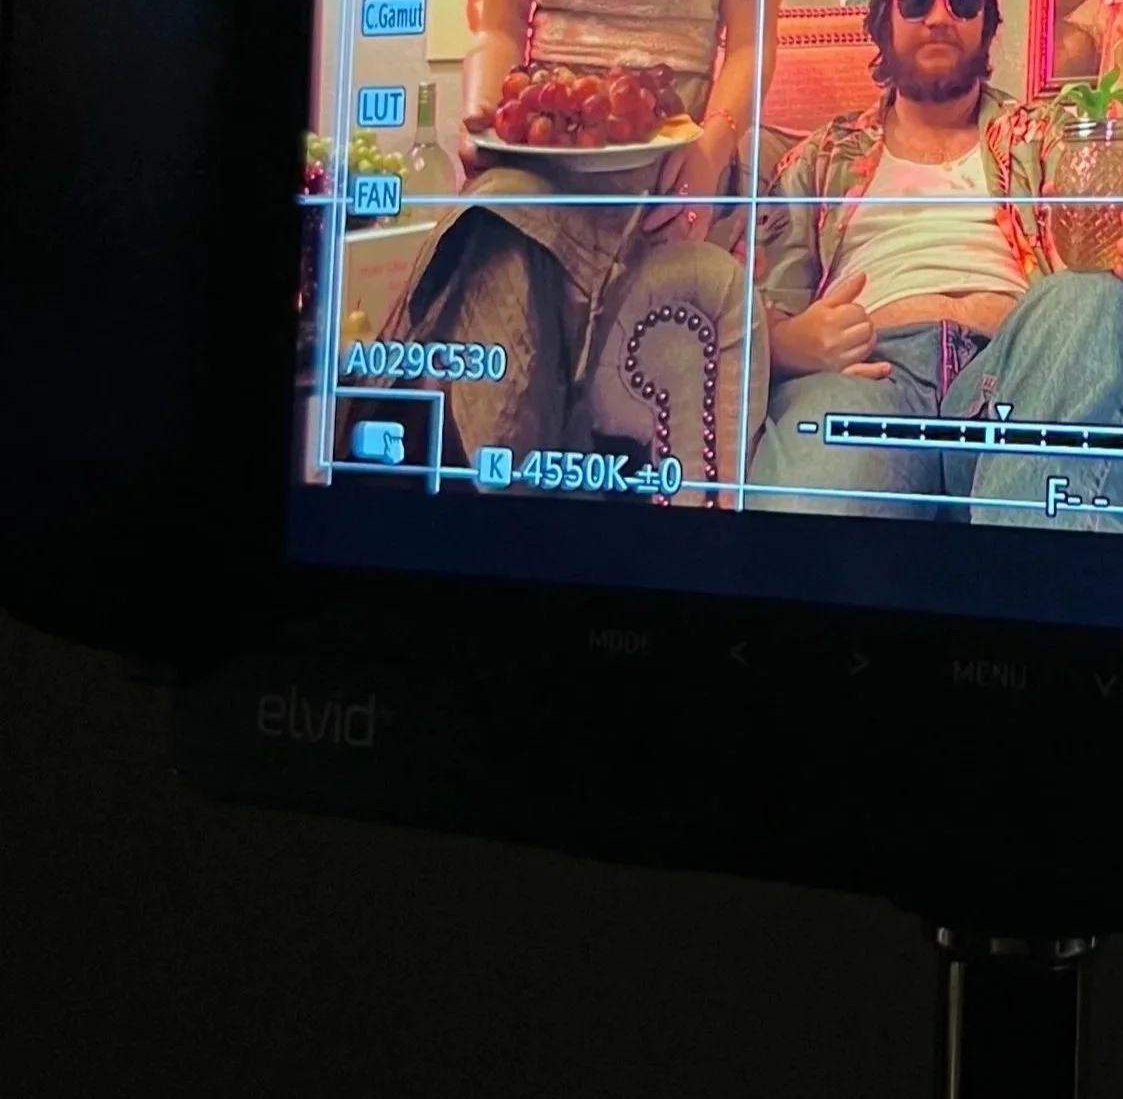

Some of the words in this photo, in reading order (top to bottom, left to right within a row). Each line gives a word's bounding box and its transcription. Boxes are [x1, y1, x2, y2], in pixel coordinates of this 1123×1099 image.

[364, 2, 425, 30] C.Gamut
[361, 93, 403, 123] LUT
[357, 181, 399, 210] FAN
[345, 340, 508, 382] A029C530
[489, 454, 504, 480] K
[522, 450, 628, 492] 4550K
[636, 456, 683, 494] ±0
[952, 660, 1027, 690] MENU
[257, 683, 376, 748] elvid
